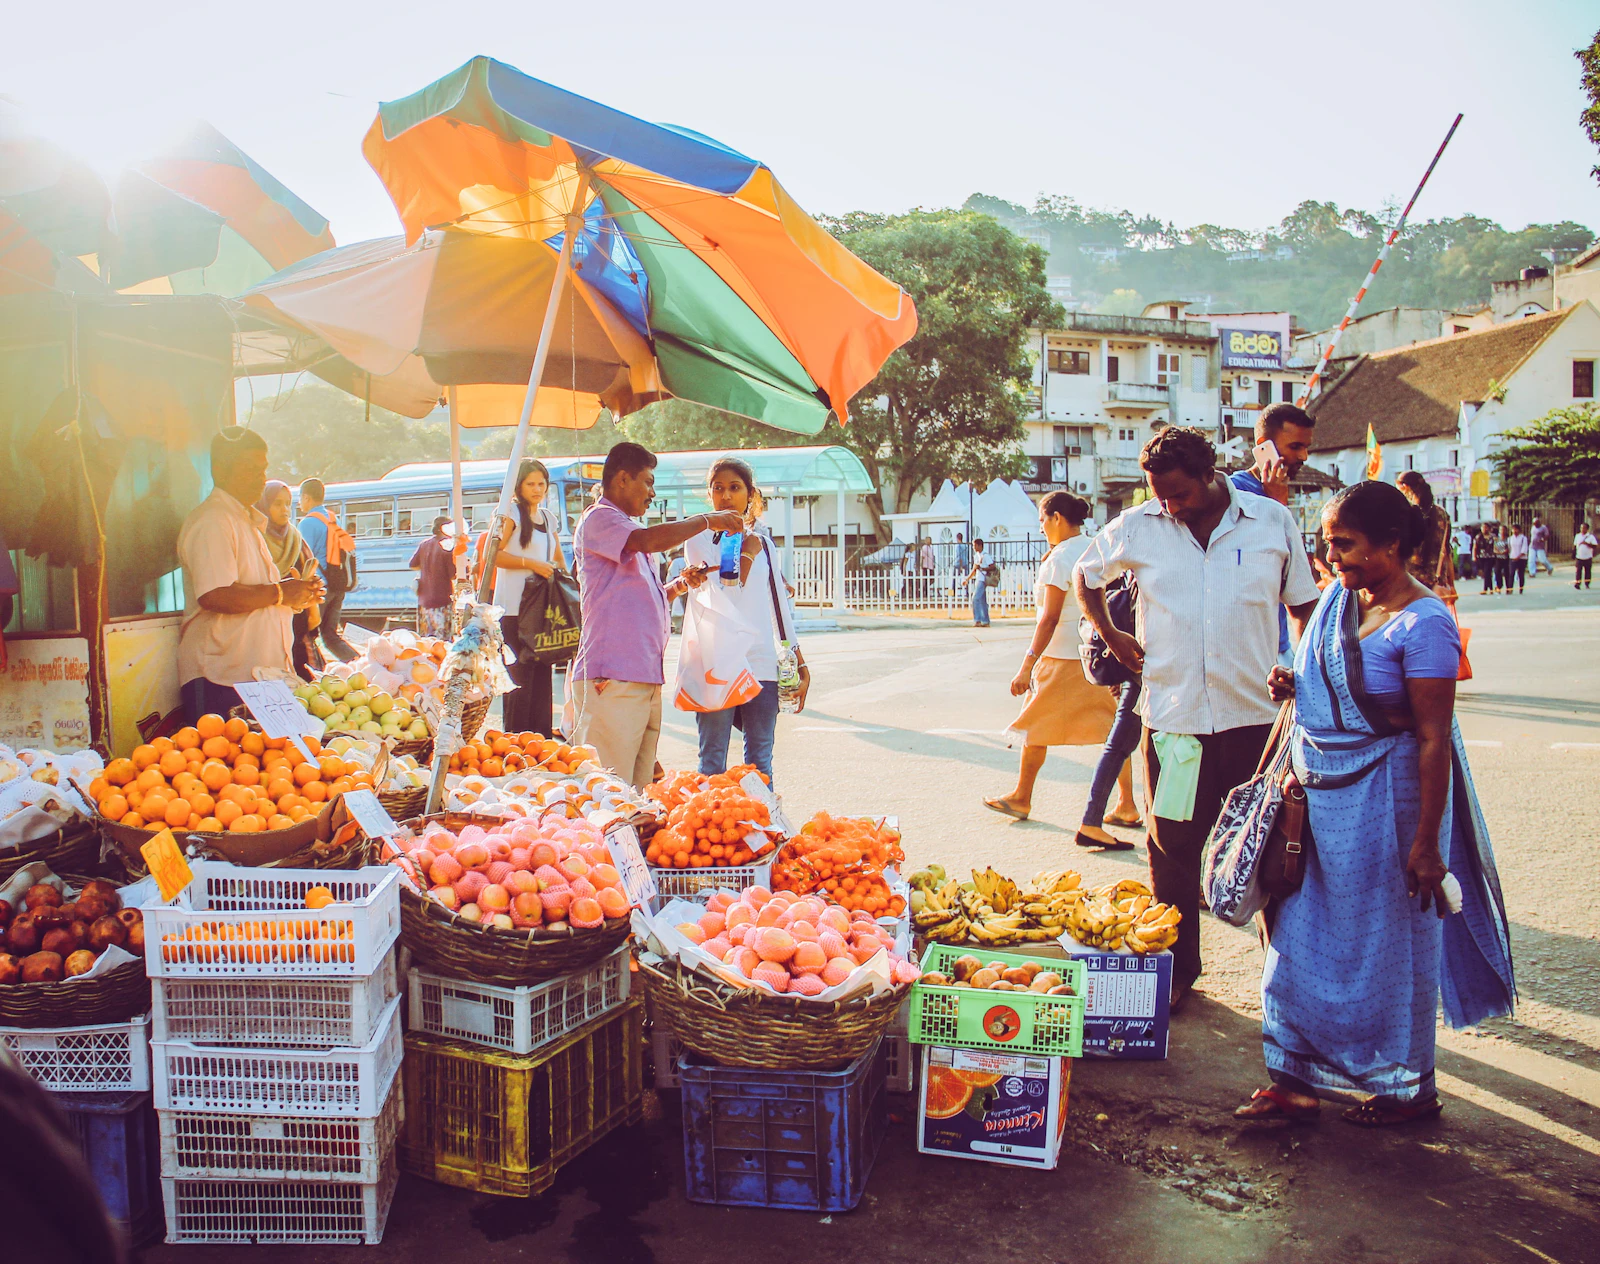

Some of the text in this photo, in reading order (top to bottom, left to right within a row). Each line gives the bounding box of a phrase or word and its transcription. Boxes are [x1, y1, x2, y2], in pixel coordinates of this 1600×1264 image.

[1228, 357, 1281, 369] EDUCATIONAL
[534, 629, 580, 648] Tulips
[738, 677, 753, 696] NIKE
[1125, 1020, 1154, 1035] Sweet
[984, 1106, 1045, 1132] Kinnow
